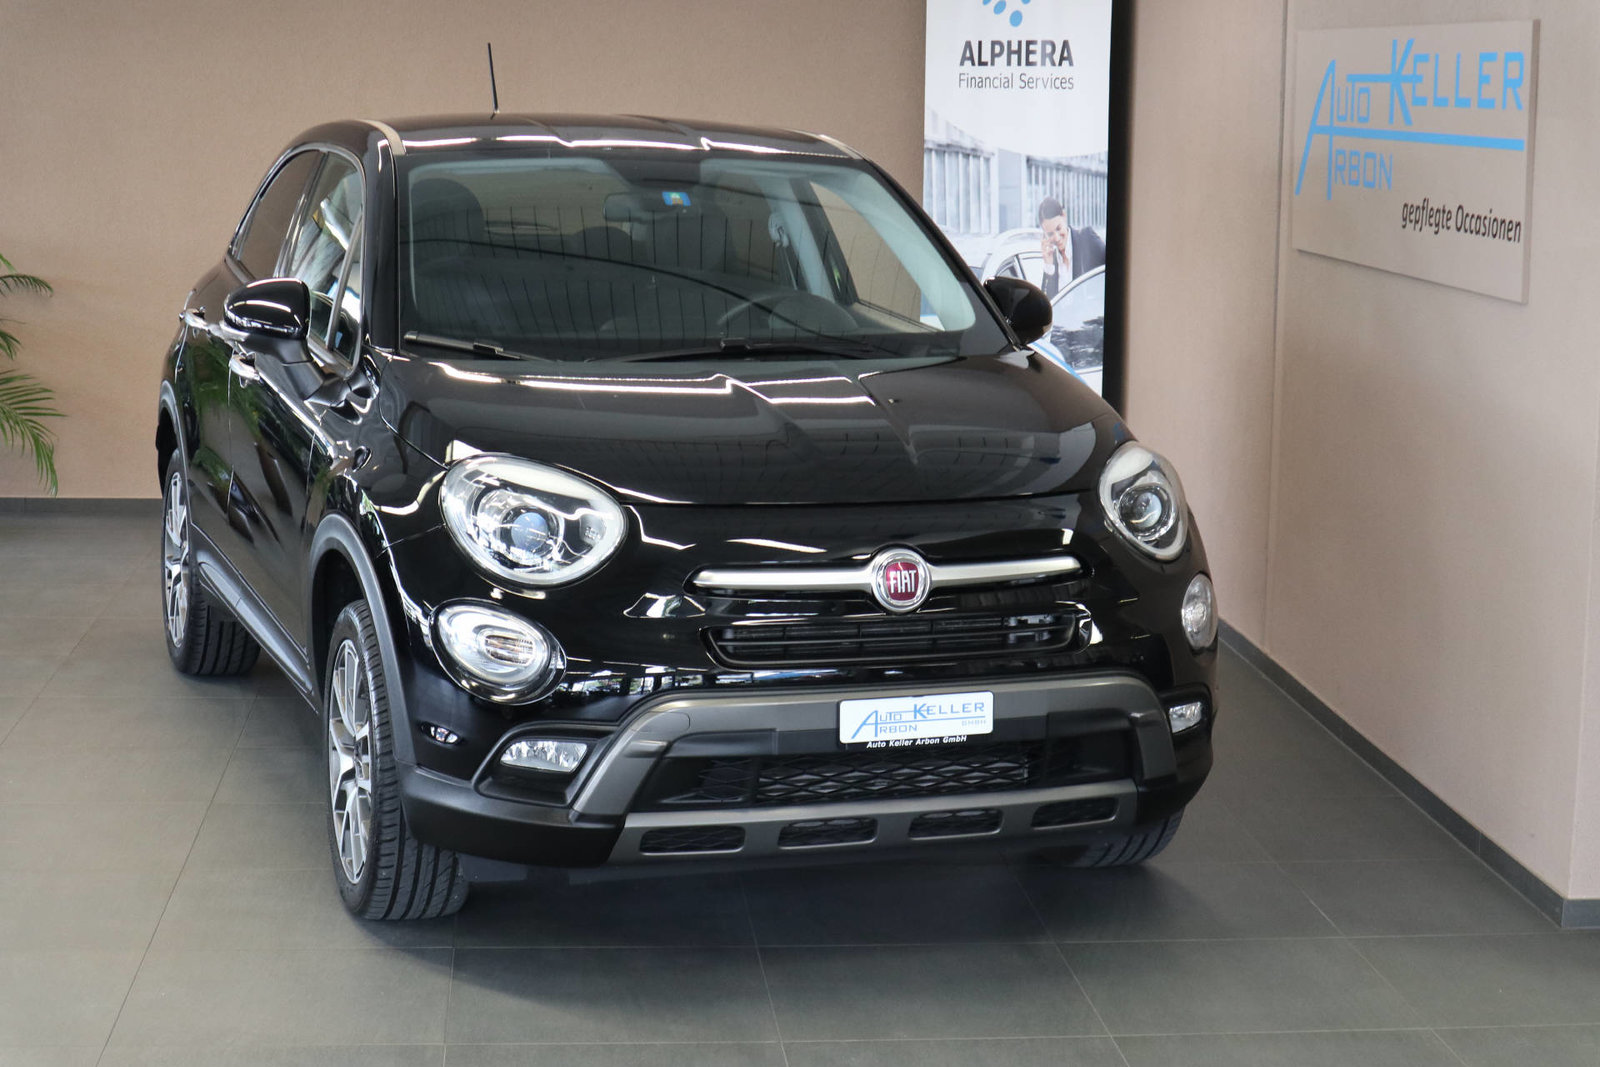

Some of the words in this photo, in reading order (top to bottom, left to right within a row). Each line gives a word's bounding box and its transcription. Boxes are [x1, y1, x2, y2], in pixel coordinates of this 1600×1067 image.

[959, 39, 1074, 67] ALPHERA
[958, 72, 1014, 89] Financial
[1019, 73, 1074, 90] Services
[1388, 38, 1525, 126] KELLER
[1401, 198, 1452, 235] gepflegte
[1454, 204, 1522, 244] Occasionen
[889, 569, 917, 594] FIAT
[913, 702, 985, 720] KELLER
[866, 741, 886, 749] Auto
[888, 739, 913, 748] Keller
[915, 737, 940, 746] Arbon
[943, 735, 967, 743] GmbH
